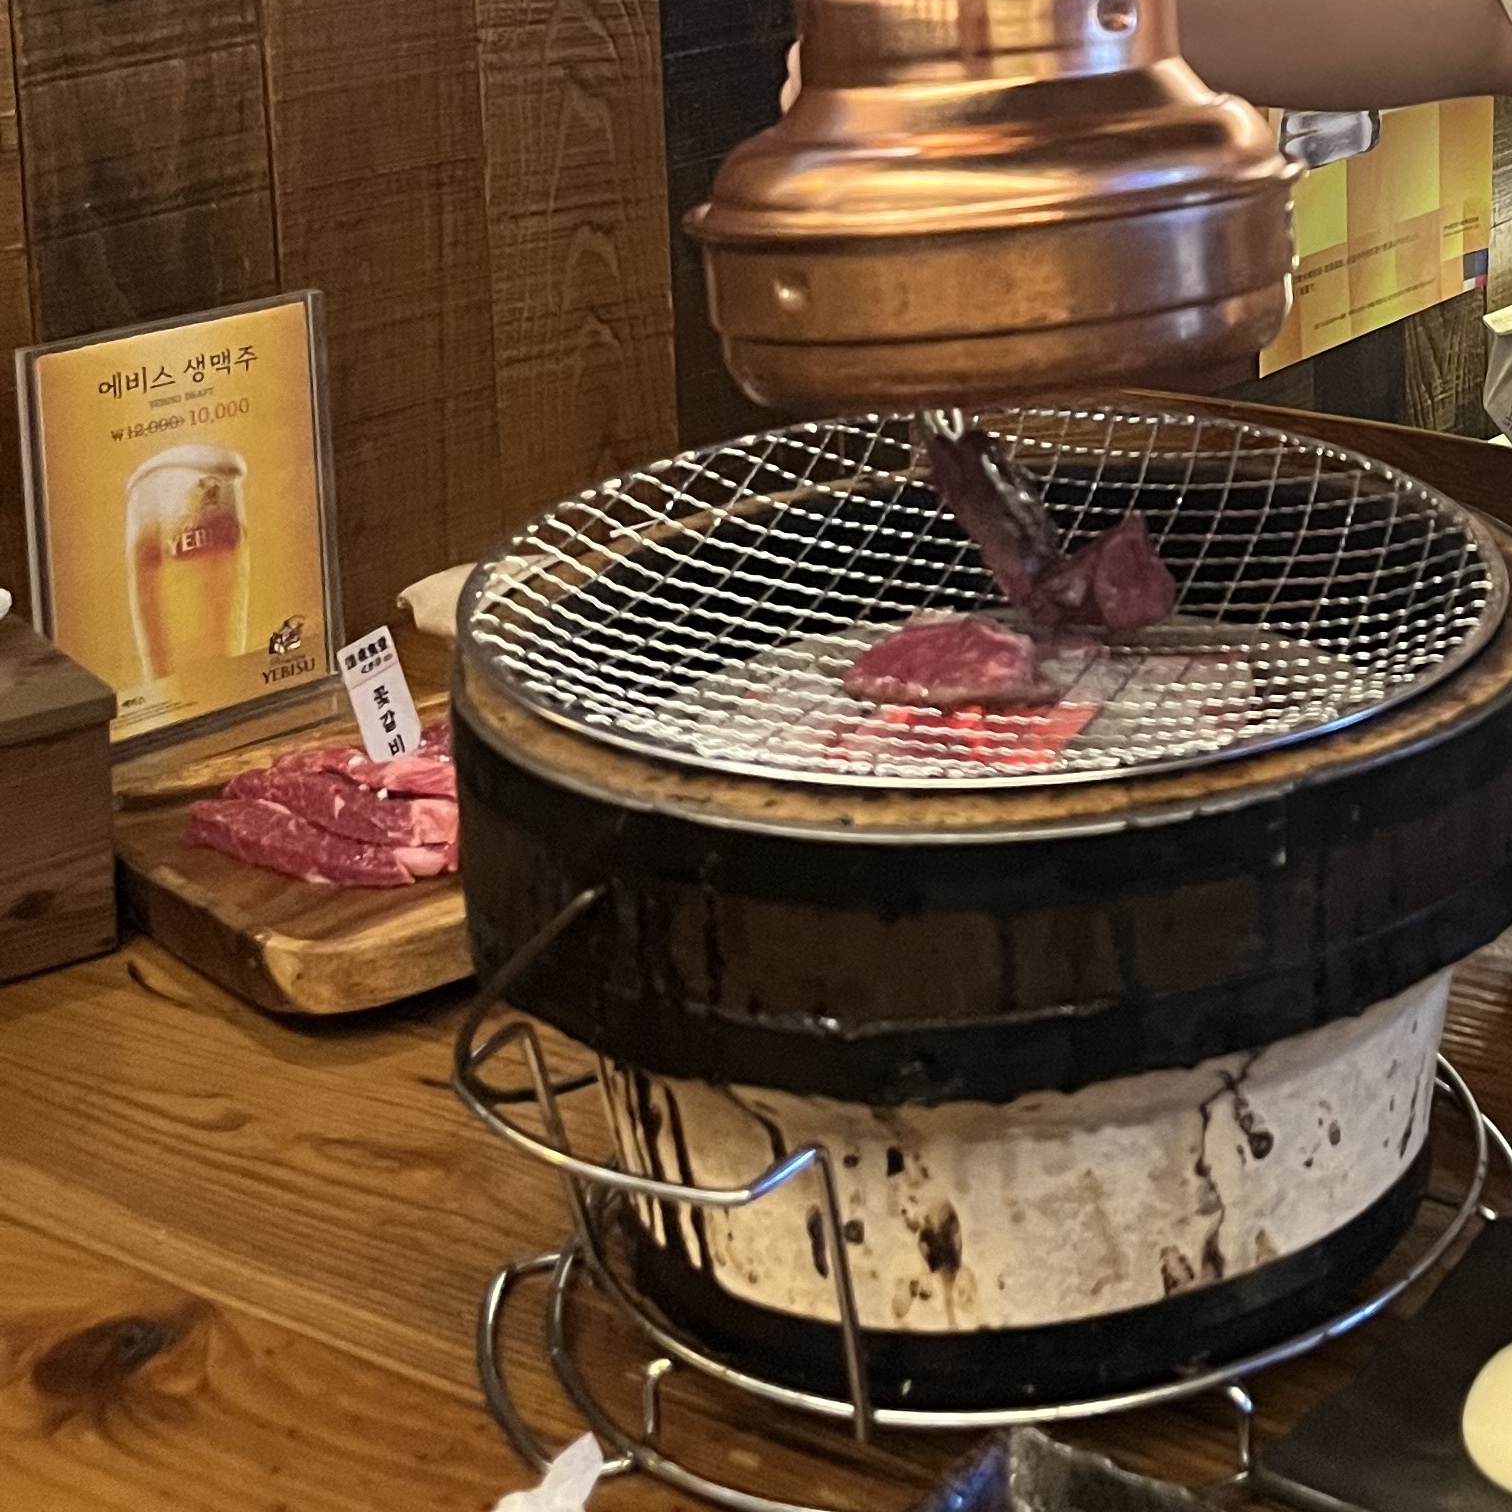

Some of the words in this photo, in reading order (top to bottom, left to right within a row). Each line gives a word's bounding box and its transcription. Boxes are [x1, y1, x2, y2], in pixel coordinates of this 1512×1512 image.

[98, 366, 177, 400] 에비스
[183, 345, 259, 384] 생맥주
[188, 397, 251, 427] 10,000
[261, 657, 316, 686] YEBISU
